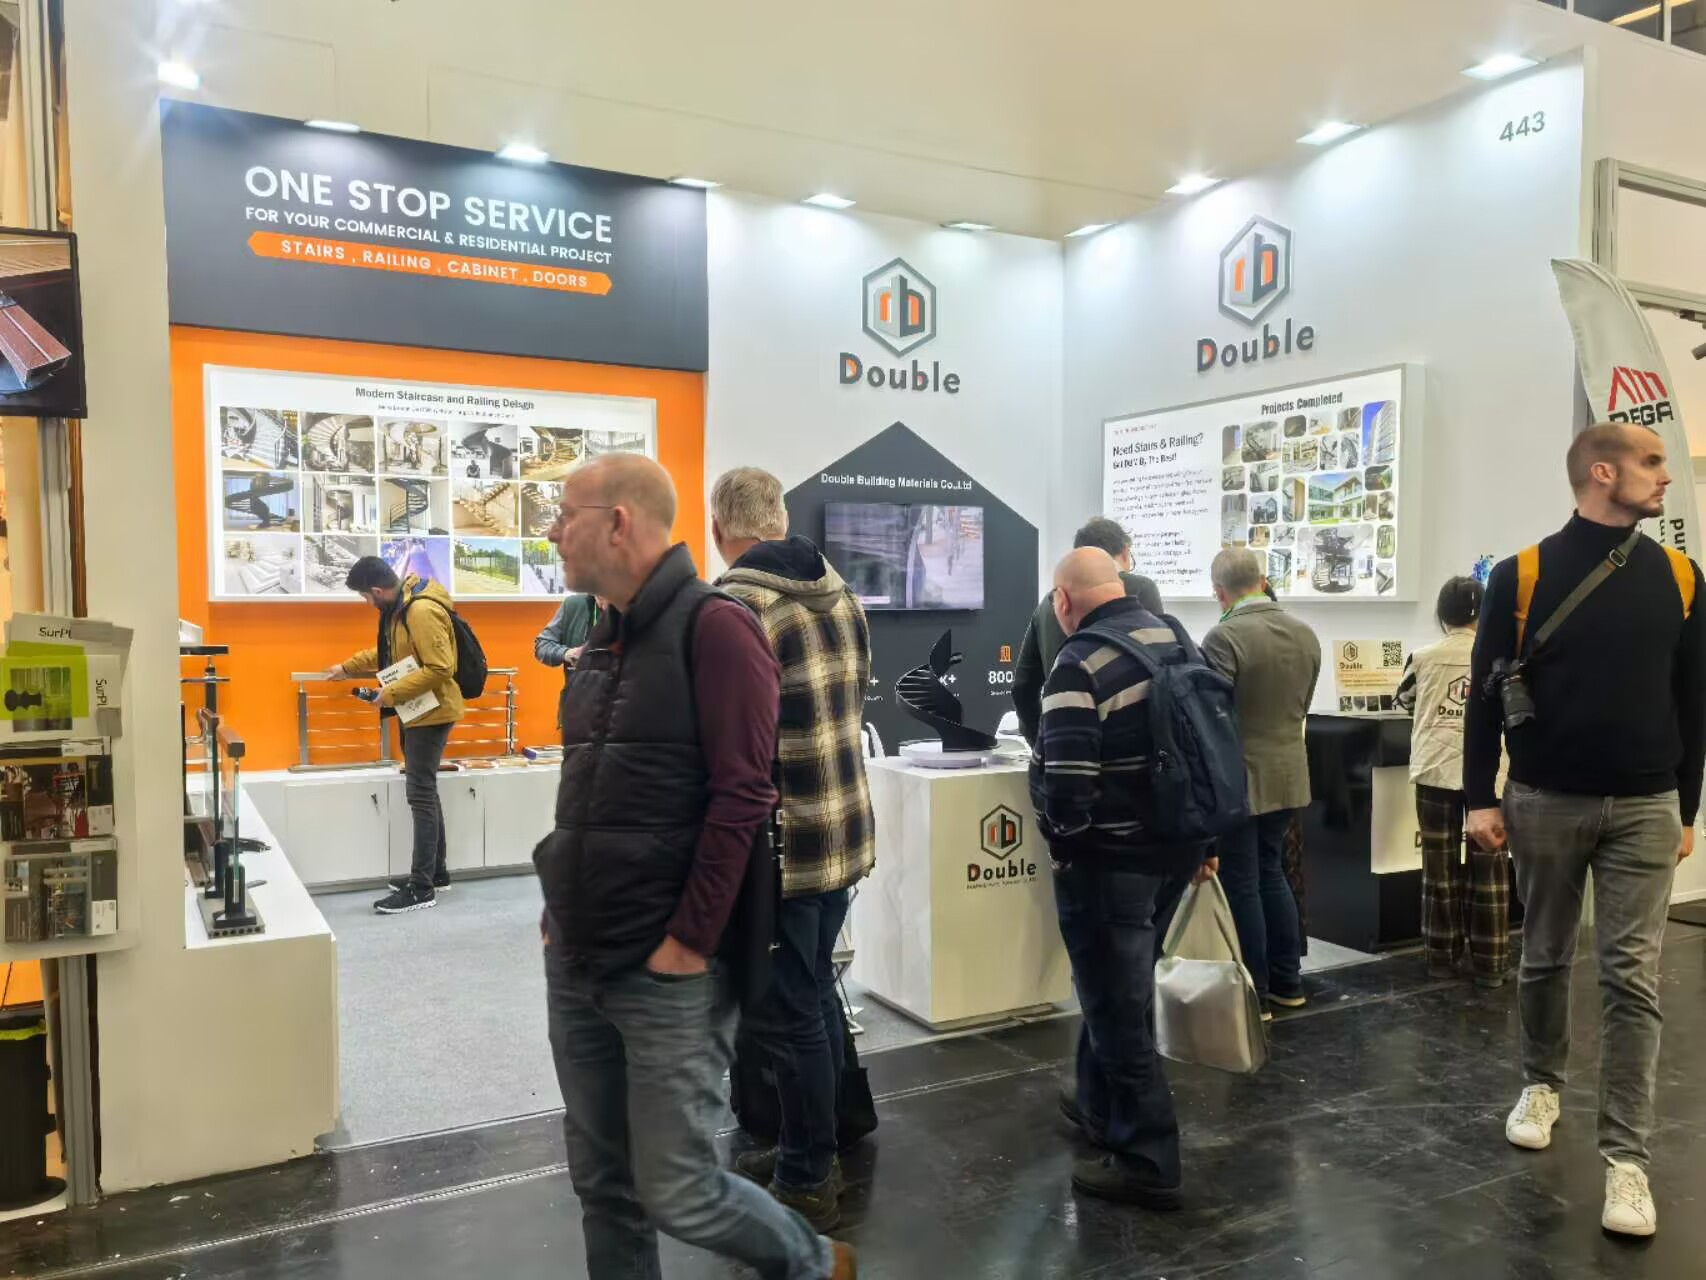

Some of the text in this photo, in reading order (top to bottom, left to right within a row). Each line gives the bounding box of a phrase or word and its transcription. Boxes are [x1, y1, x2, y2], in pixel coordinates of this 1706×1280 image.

[1499, 110, 1545, 142] 443
[245, 166, 612, 243] ONE STOP SERVICE
[245, 207, 612, 264] FOR YOUR COMMERCIAL & RESIDENTIAL PROJECT
[281, 240, 345, 259] STAIRS
[363, 250, 431, 269] RAILING
[447, 261, 518, 280] CABINET
[533, 271, 588, 287] DOORS
[1197, 318, 1314, 373] Double
[839, 352, 961, 394] Double
[355, 387, 395, 399] Modern
[397, 390, 444, 403] Staircase
[446, 395, 464, 405] and
[467, 396, 500, 409] Railing
[1261, 392, 1343, 415] Projects Completed
[1134, 441, 1158, 453] Stairs
[821, 473, 855, 485] Double
[857, 475, 896, 488] Building
[898, 477, 938, 489] Materials
[1438, 705, 1463, 716] Dou
[968, 858, 1037, 882] Double
